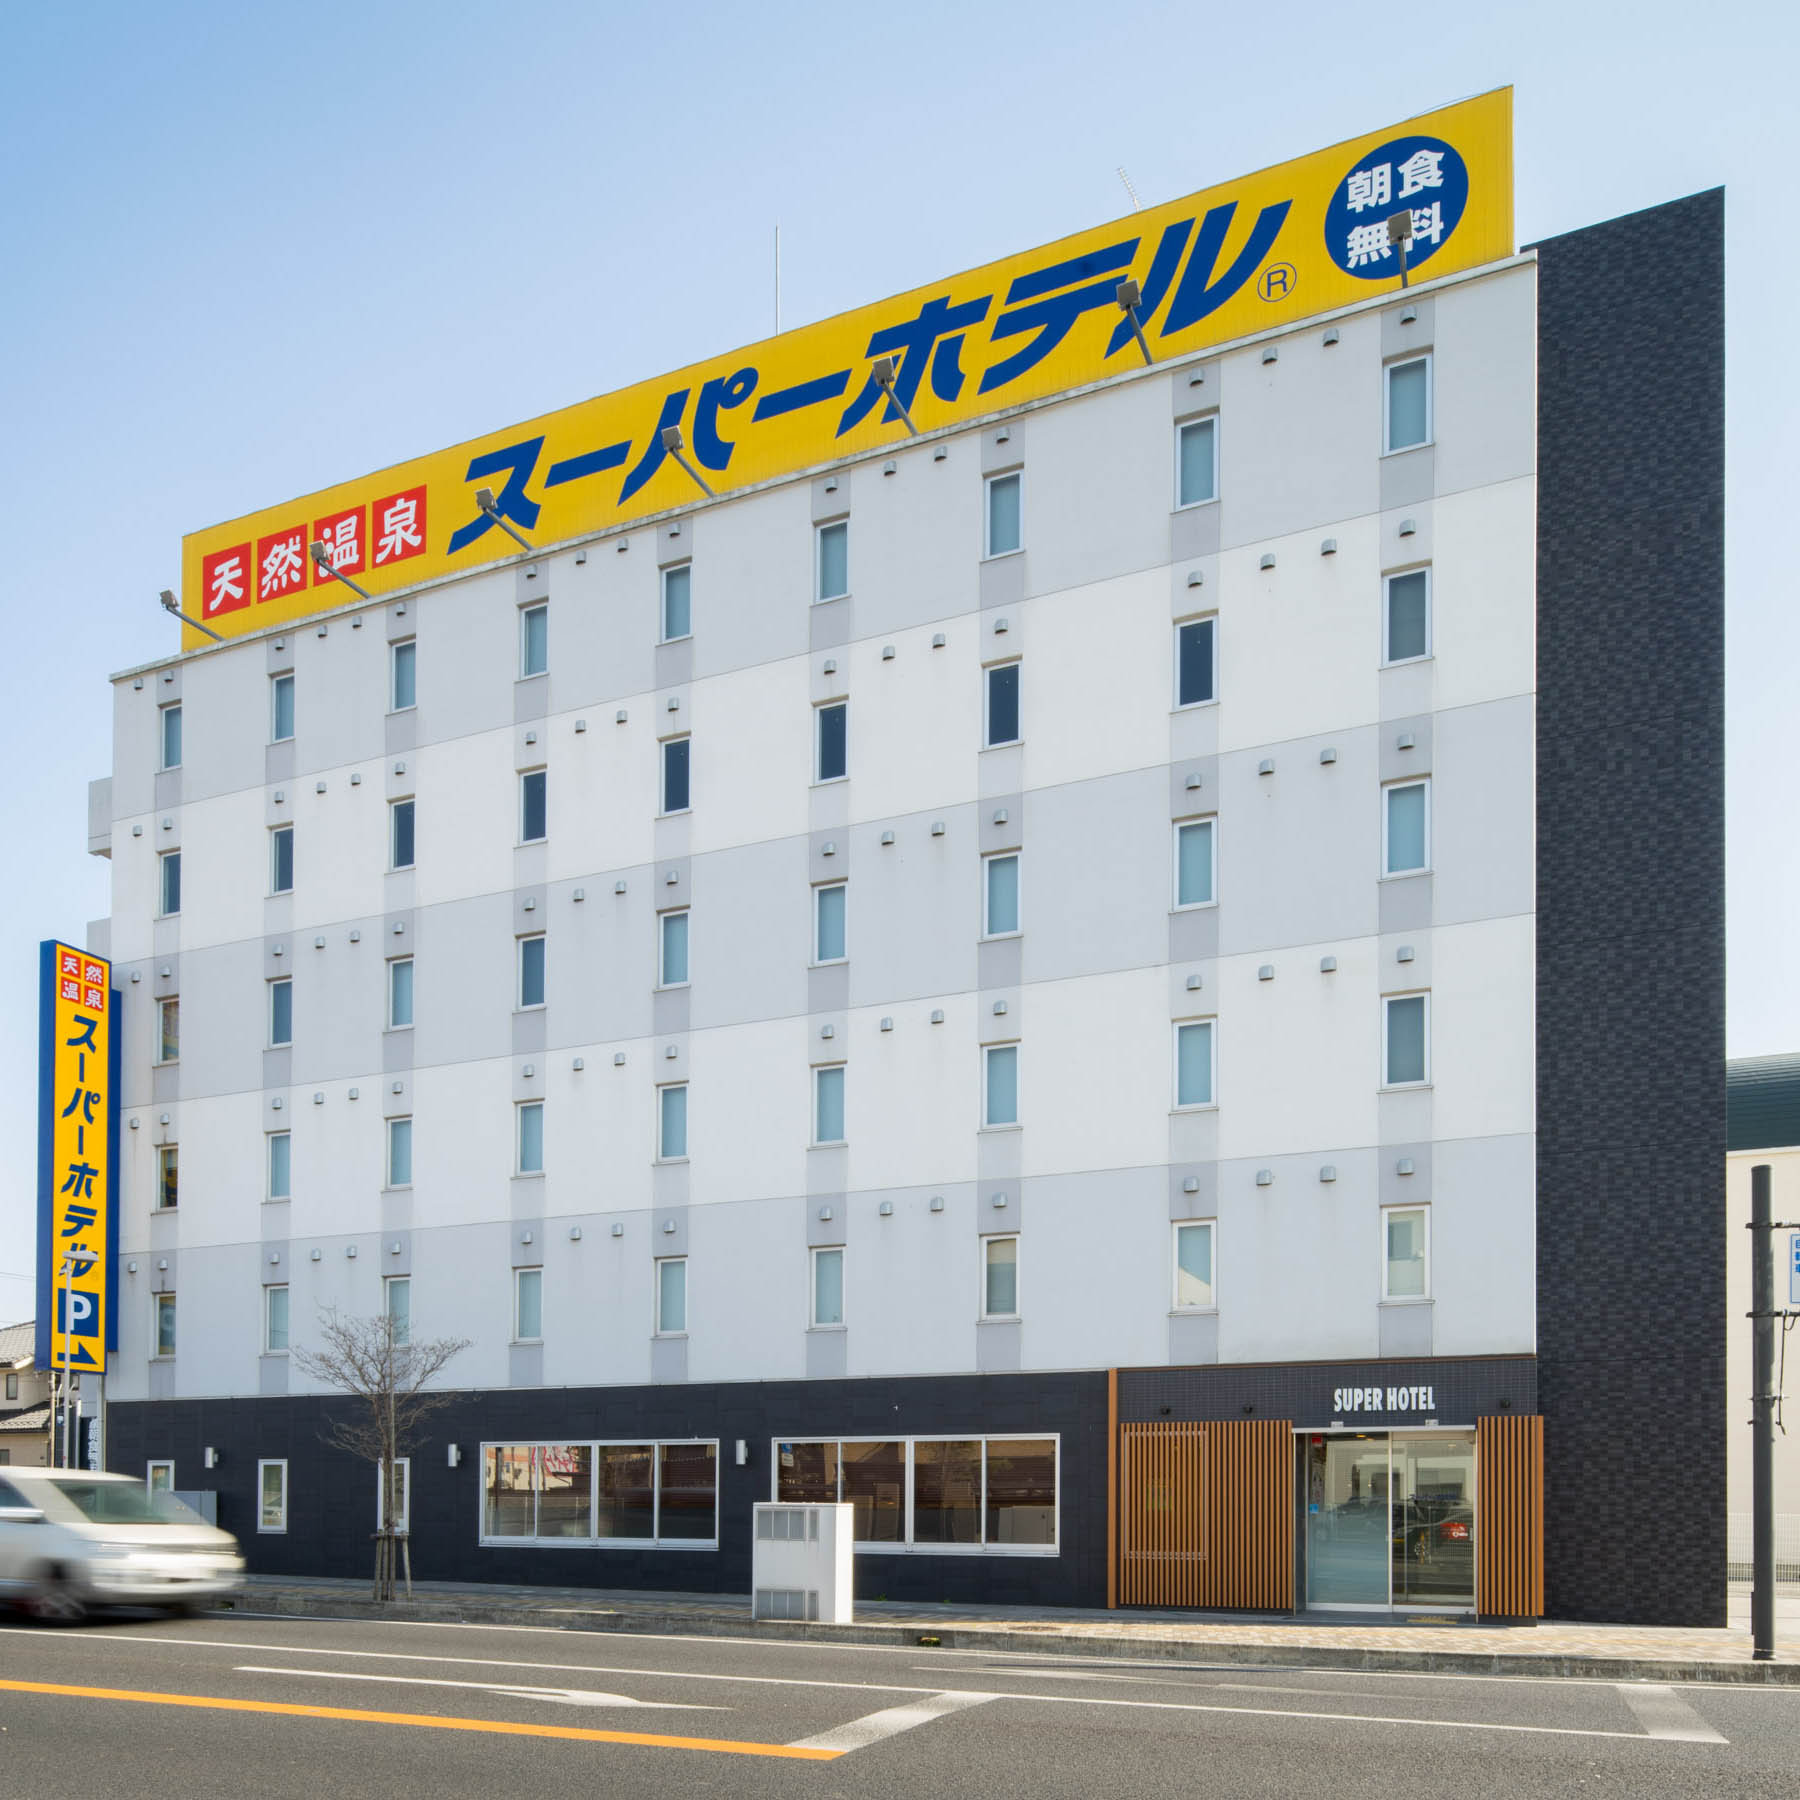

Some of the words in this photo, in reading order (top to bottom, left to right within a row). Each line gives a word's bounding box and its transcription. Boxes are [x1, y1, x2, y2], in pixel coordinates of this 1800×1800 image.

[1346, 149, 1445, 213] 朝食
[1346, 201, 1444, 269] 無料
[447, 198, 1293, 554] スーパーホテル
[209, 498, 423, 611] 天然温泉
[68, 1293, 92, 1331] P
[1334, 1387, 1383, 1412] SUPER
[1386, 1386, 1435, 1411] HOTEL
